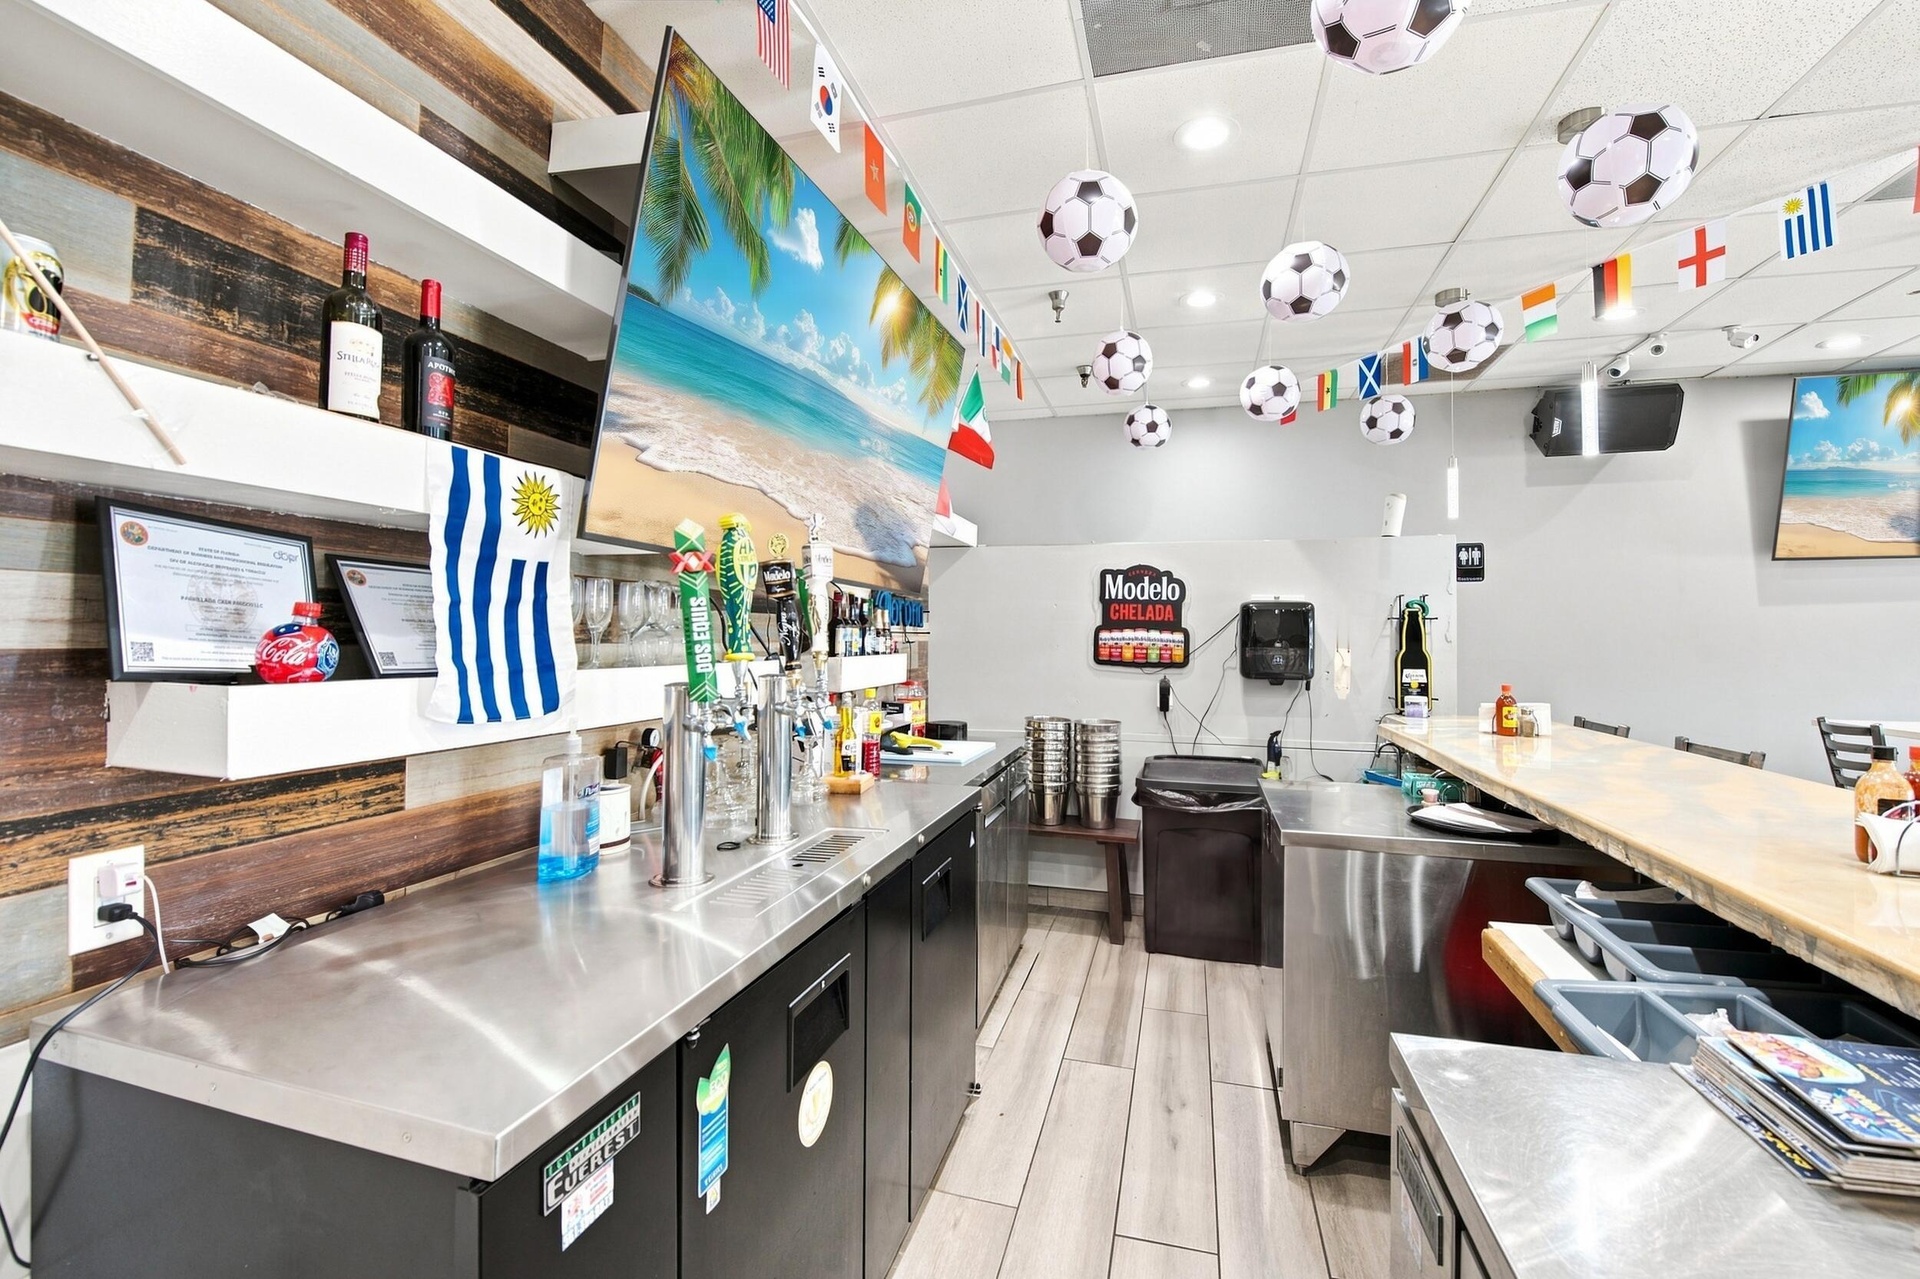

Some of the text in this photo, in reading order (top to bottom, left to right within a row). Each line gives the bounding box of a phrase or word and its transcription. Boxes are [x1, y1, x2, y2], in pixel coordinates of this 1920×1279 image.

[1105, 574, 1179, 601] Modelo
[1110, 604, 1173, 621] CHELADA
[690, 596, 713, 673] DOS EQUIS
